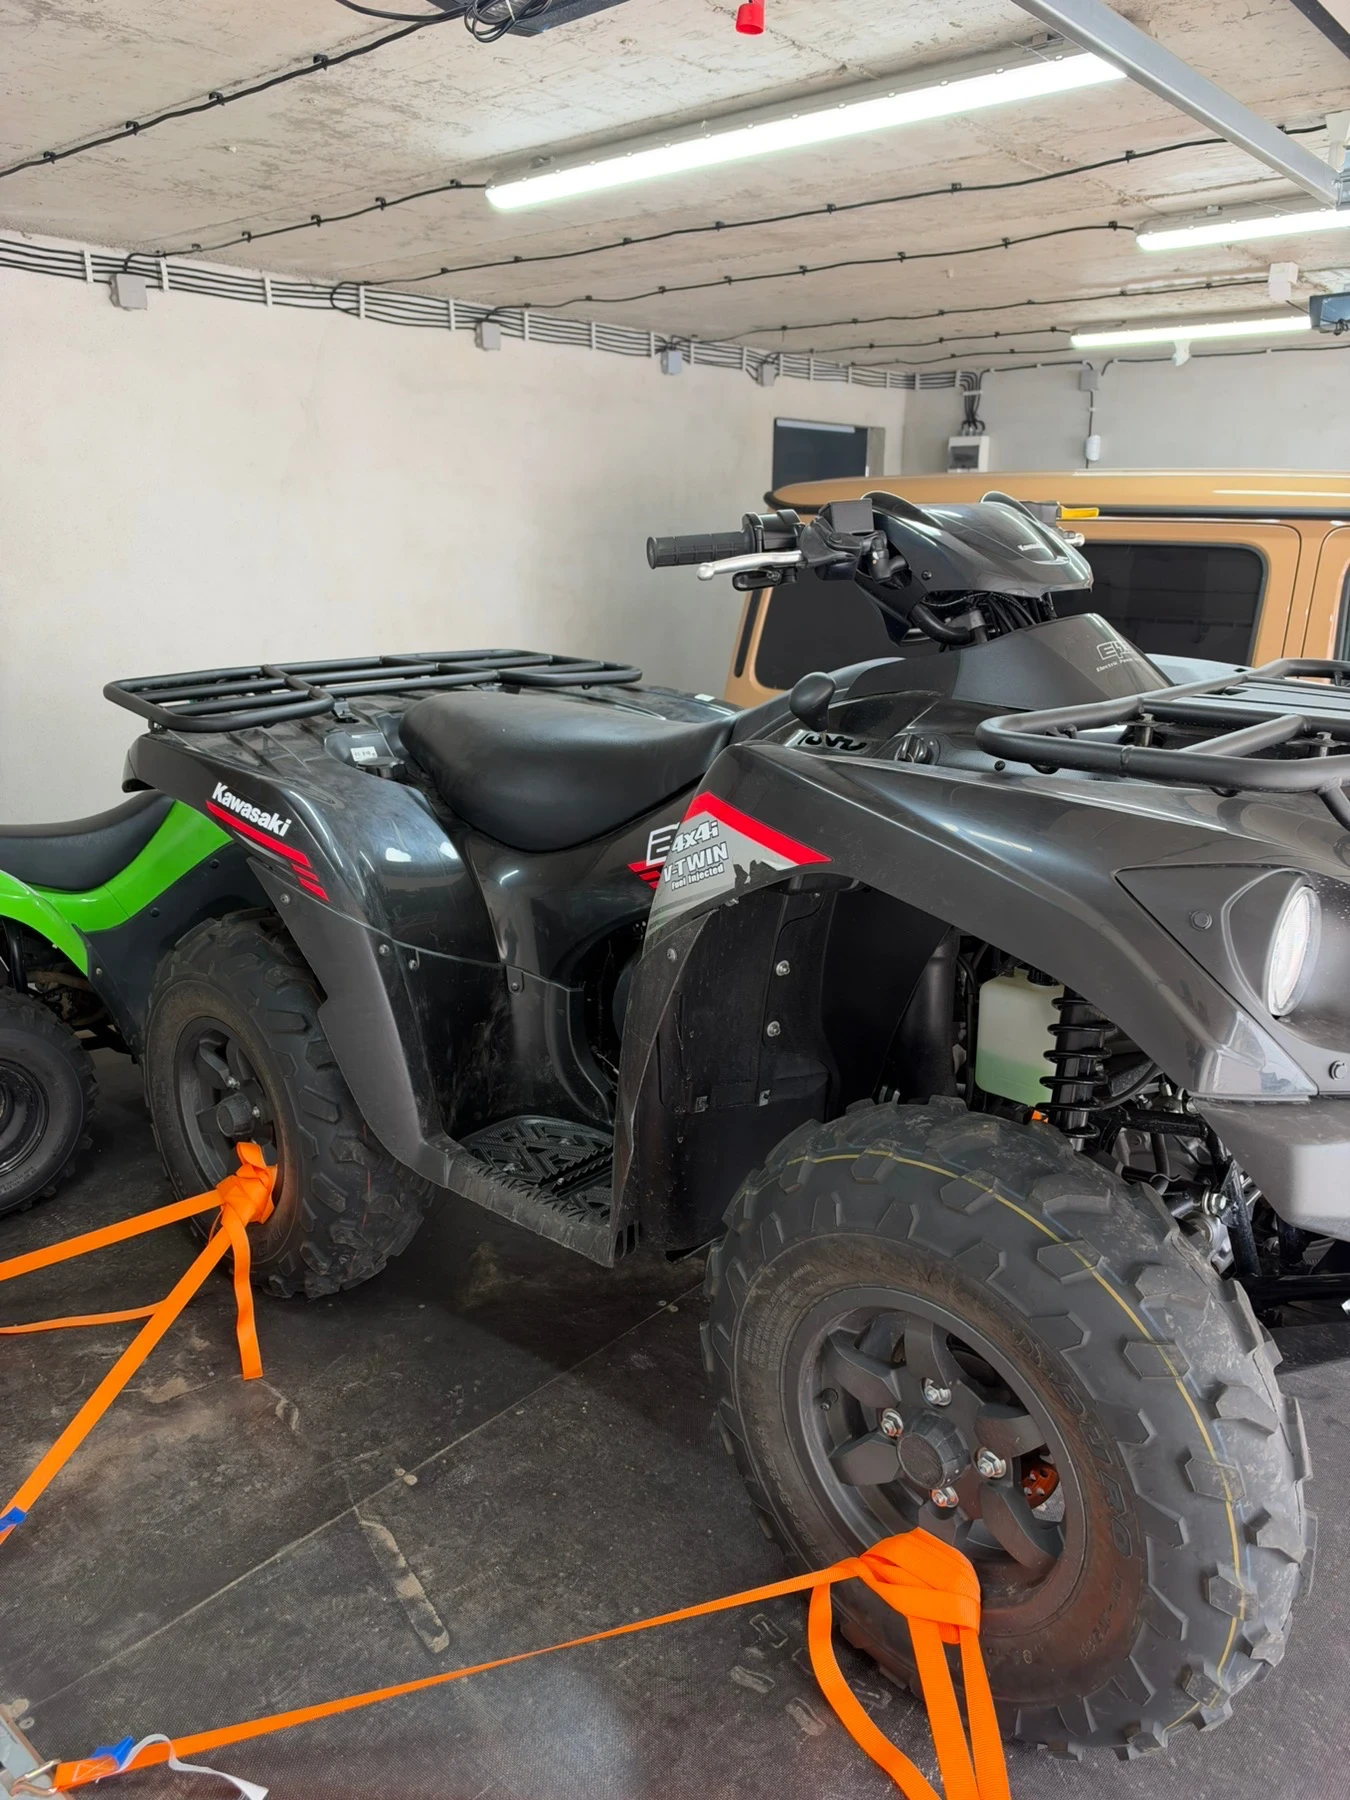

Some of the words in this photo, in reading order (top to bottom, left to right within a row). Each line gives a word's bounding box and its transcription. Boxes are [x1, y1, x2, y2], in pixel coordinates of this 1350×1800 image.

[212, 782, 292, 836] Kawasaki
[672, 821, 719, 852] 4x4i
[664, 842, 728, 883] V-TWIN
[671, 876, 687, 891] Fuel
[688, 863, 725, 884] Injected
